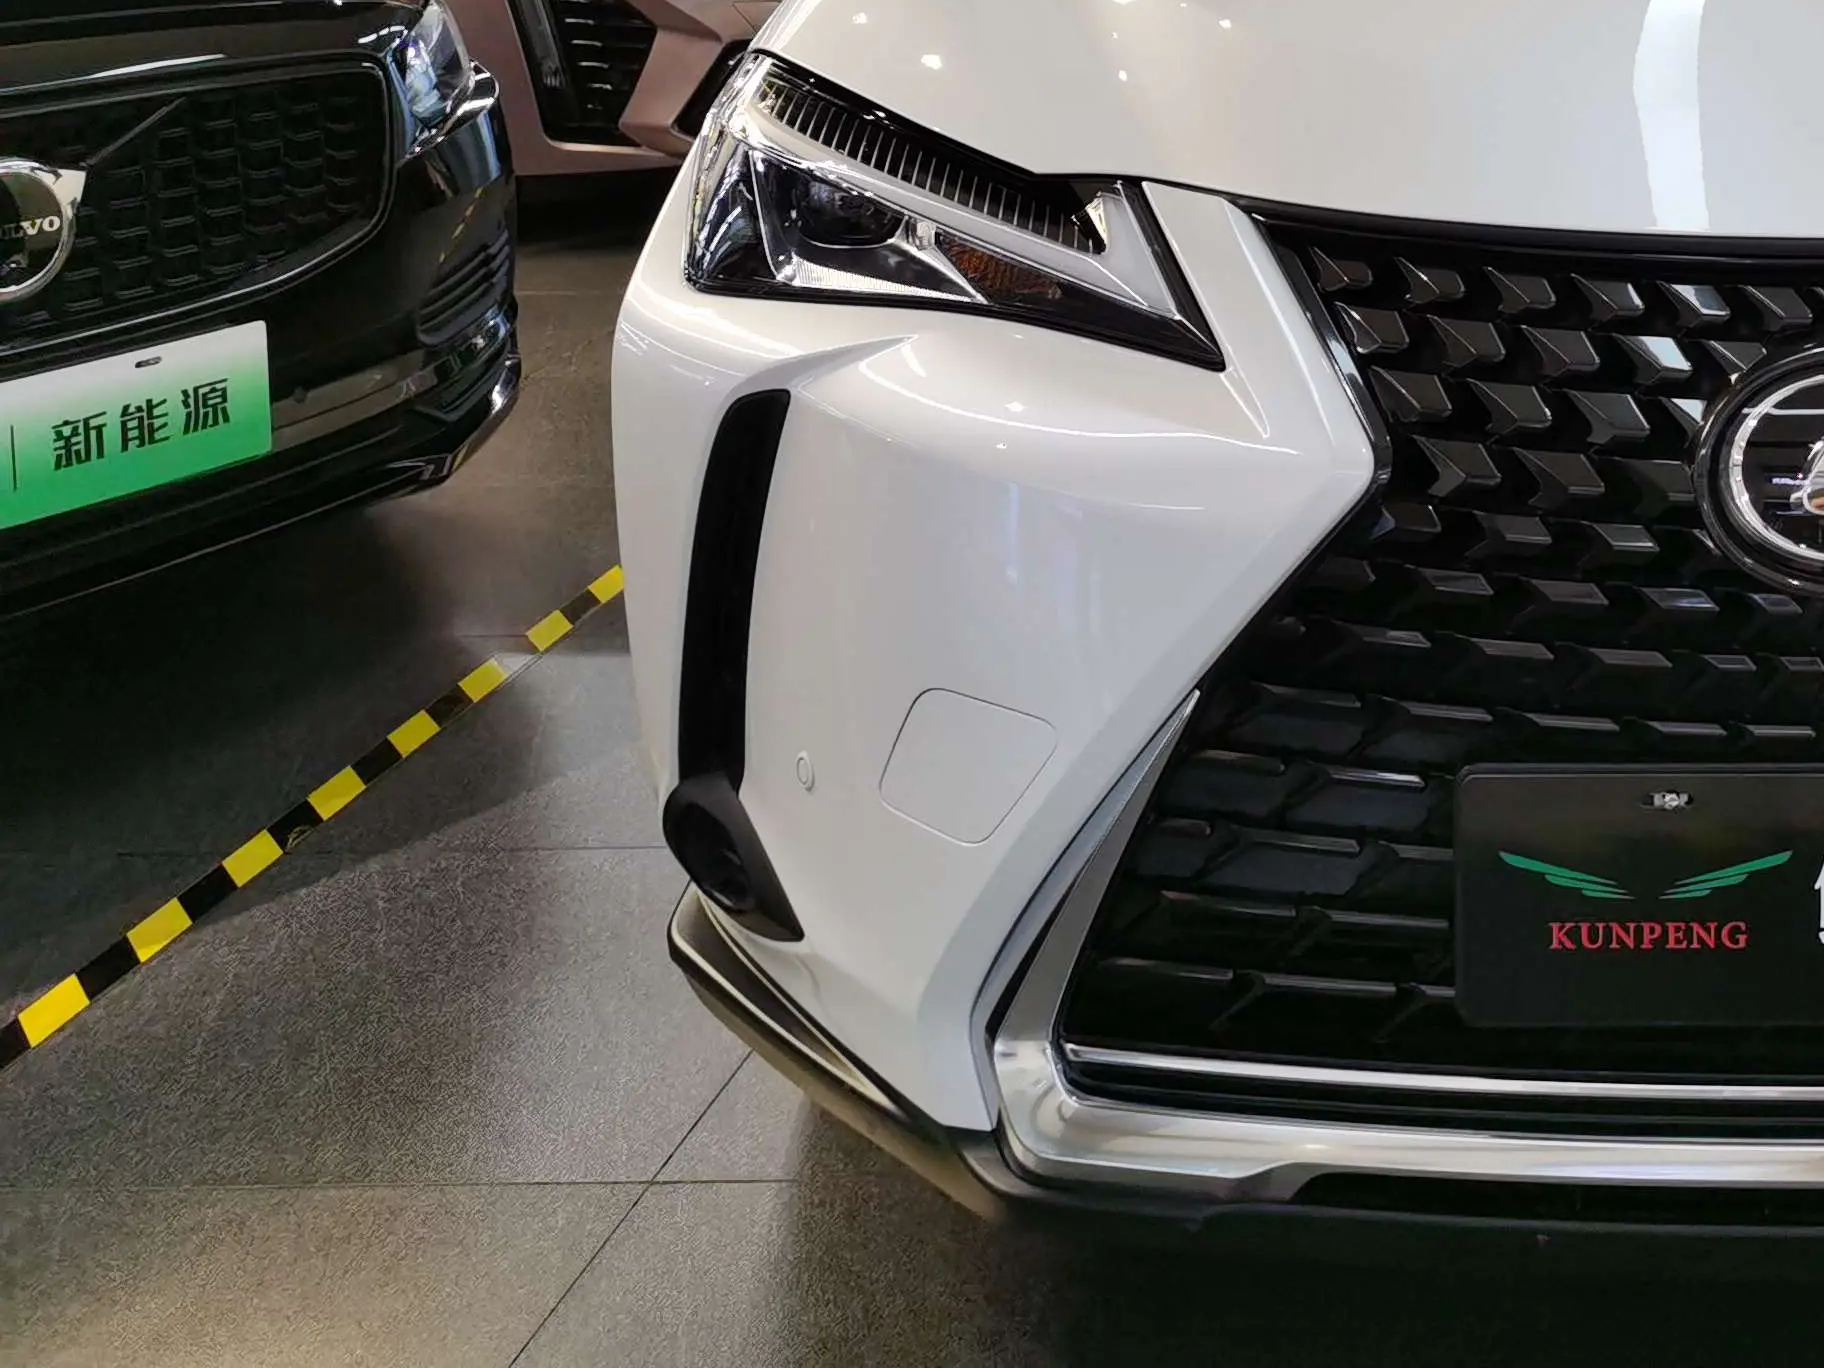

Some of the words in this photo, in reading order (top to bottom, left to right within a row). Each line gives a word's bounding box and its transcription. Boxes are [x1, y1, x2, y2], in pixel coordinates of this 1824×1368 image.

[51, 377, 232, 472] 新能源
[1547, 920, 1750, 952] KUNPENG
